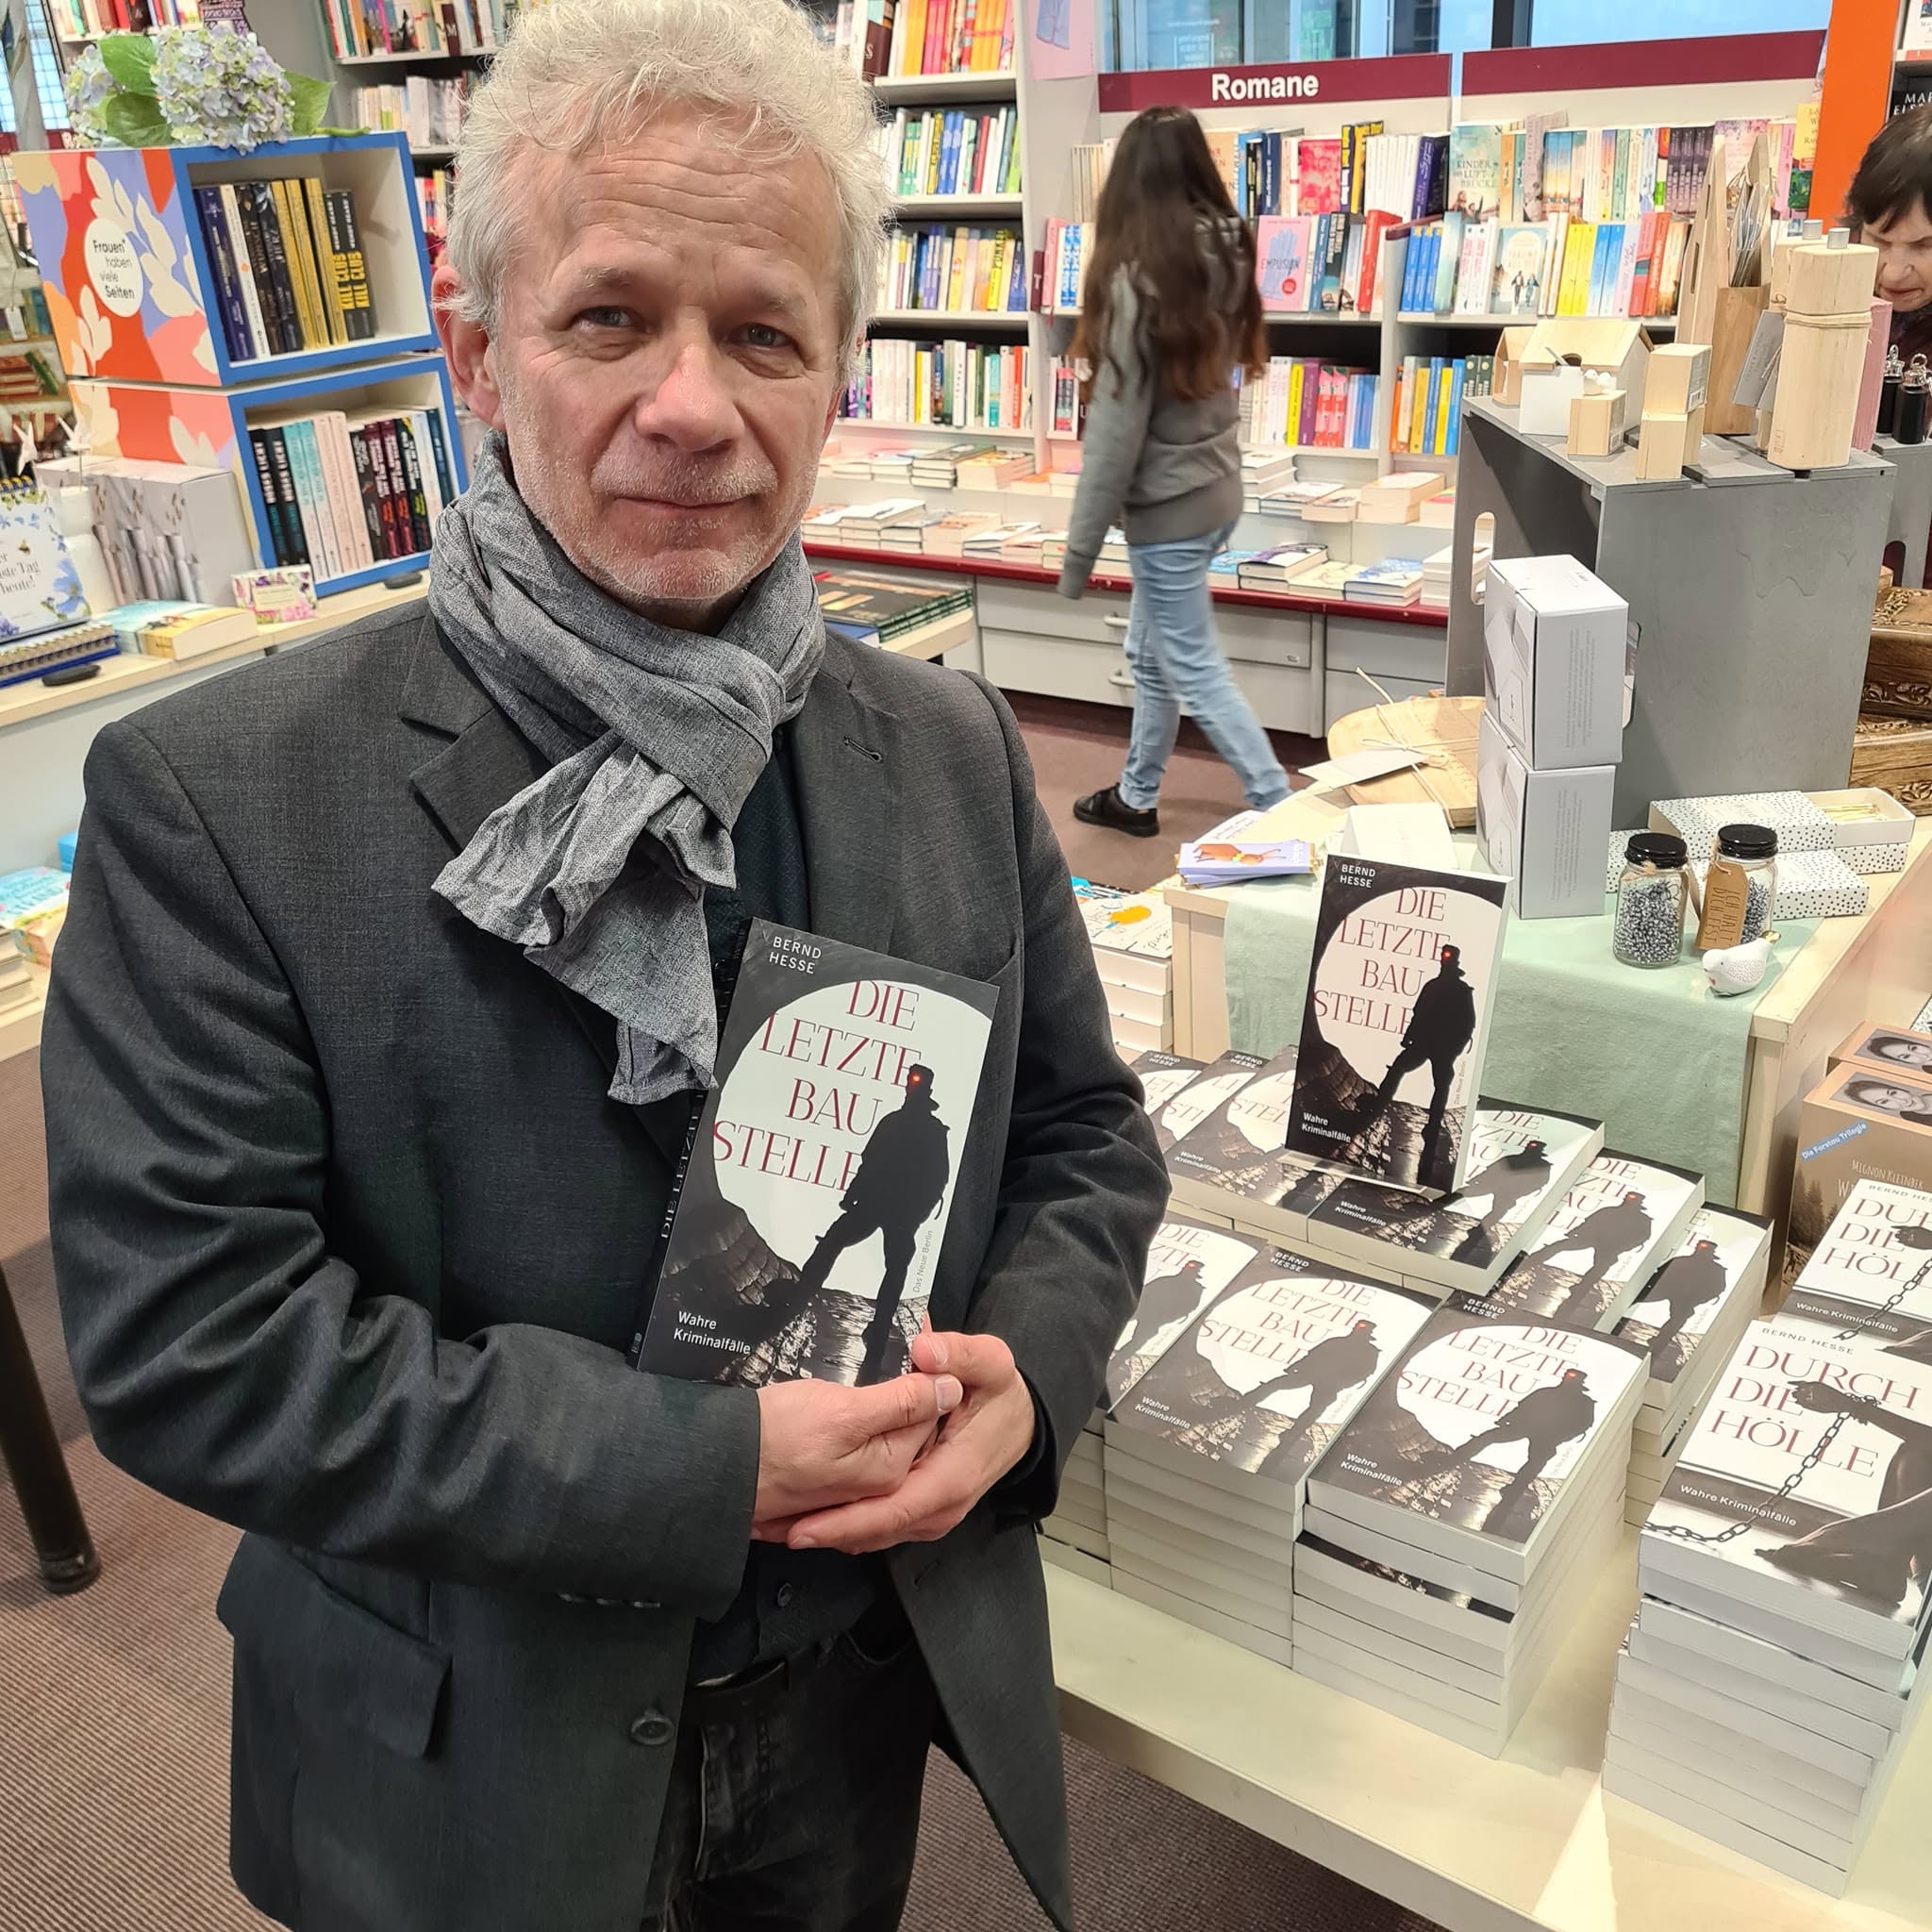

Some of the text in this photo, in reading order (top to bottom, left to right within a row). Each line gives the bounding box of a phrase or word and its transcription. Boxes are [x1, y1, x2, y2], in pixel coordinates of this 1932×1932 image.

[1211, 74, 1319, 101] Romane
[105, 285, 135, 299] Seiten
[1340, 875, 1374, 889] HESSE
[1341, 864, 1376, 877] BERND
[1395, 888, 1447, 921] DIE
[773, 936, 823, 960] BERND
[1339, 917, 1451, 962] LETZTE
[769, 951, 816, 974] HESSE
[1359, 958, 1425, 997] BAU
[845, 979, 920, 1032] DIE
[758, 1012, 923, 1088] LETZTE
[1149, 1058, 1175, 1067] HESSE
[1153, 1054, 1181, 1063] BERND
[1234, 1054, 1263, 1066] BERND
[1229, 1058, 1257, 1069] HESSE
[785, 1077, 884, 1136] BAU
[1229, 1097, 1288, 1125] STEL
[1303, 1111, 1329, 1126] Wahre
[1301, 1123, 1352, 1143] Kriminalfälle
[1492, 1109, 1544, 1131] DIE
[1180, 1150, 1205, 1162] Wahre
[1588, 1156, 1641, 1180] DIE
[1851, 1158, 1887, 1179] MIGNON
[1868, 1184, 1908, 1198] BERND
[1334, 1206, 1387, 1227] Kriminalfälle
[1340, 1200, 1367, 1213] Wahre
[660, 1200, 677, 1240] DIE
[1157, 1223, 1211, 1249] DIE
[1838, 1222, 1906, 1253] DIE
[911, 1229, 934, 1294] Das Neue Berlin
[1270, 1257, 1305, 1274] HESSE
[1274, 1251, 1310, 1268] BERND
[1249, 1282, 1371, 1328] LETZTE
[1320, 1279, 1377, 1307] DIE
[1467, 1297, 1507, 1315] BERND
[677, 1310, 717, 1331] Wahre
[1461, 1304, 1499, 1321] HESSE
[1795, 1301, 1900, 1335] Wahre Kriminalfälle
[1259, 1311, 1333, 1343] BAU
[1520, 1325, 1582, 1355] DIE
[673, 1328, 752, 1355] Kriminalfälle
[1447, 1328, 1580, 1378] LETZTE
[1761, 1327, 1855, 1356] BERND HESSE
[1461, 1360, 1541, 1396] BAU
[1742, 1344, 1922, 1411] DURCH
[1141, 1395, 1171, 1412] Wahre
[1724, 1376, 1805, 1418] DIE
[1134, 1404, 1192, 1430] Kriminalfälle
[1707, 1408, 1879, 1479] HÖLLE
[1345, 1452, 1379, 1470] Wahre
[1340, 1461, 1404, 1488] Kriminalfälle
[1679, 1483, 1798, 1527] Wahre Kriminalfälle
